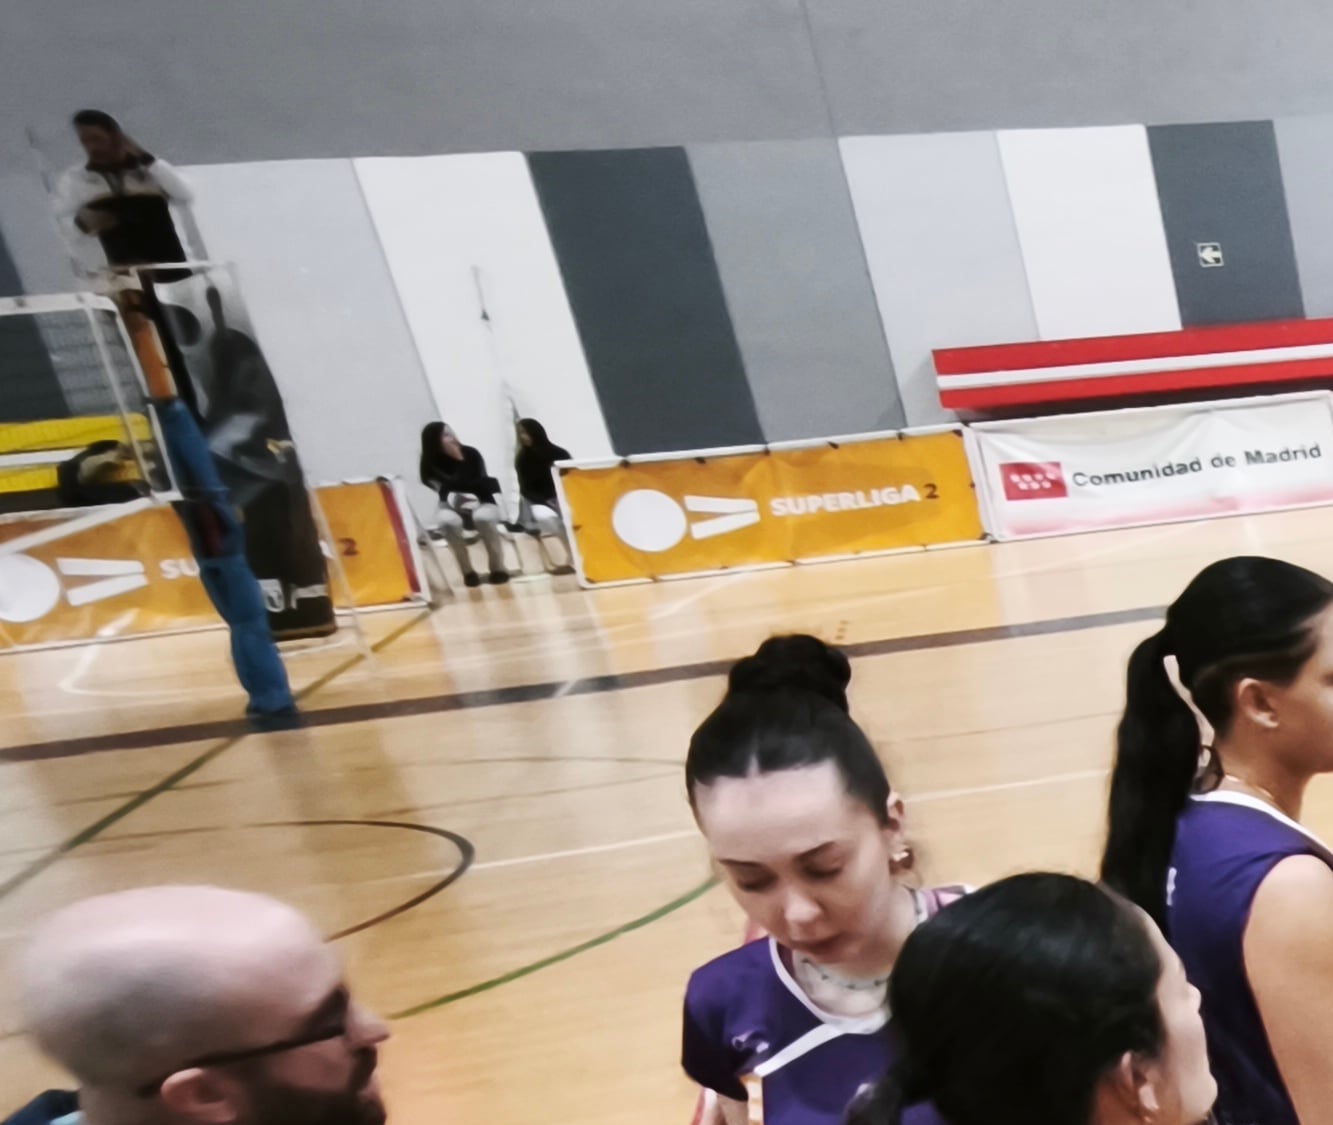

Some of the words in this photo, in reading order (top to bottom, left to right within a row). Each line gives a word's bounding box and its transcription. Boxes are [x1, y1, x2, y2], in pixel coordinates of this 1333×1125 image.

[1071, 456, 1203, 488] Comunidad
[1210, 451, 1237, 469] de
[1244, 442, 1323, 467] Madrid
[768, 484, 922, 517] SUPERLIGA
[922, 482, 940, 500] 2
